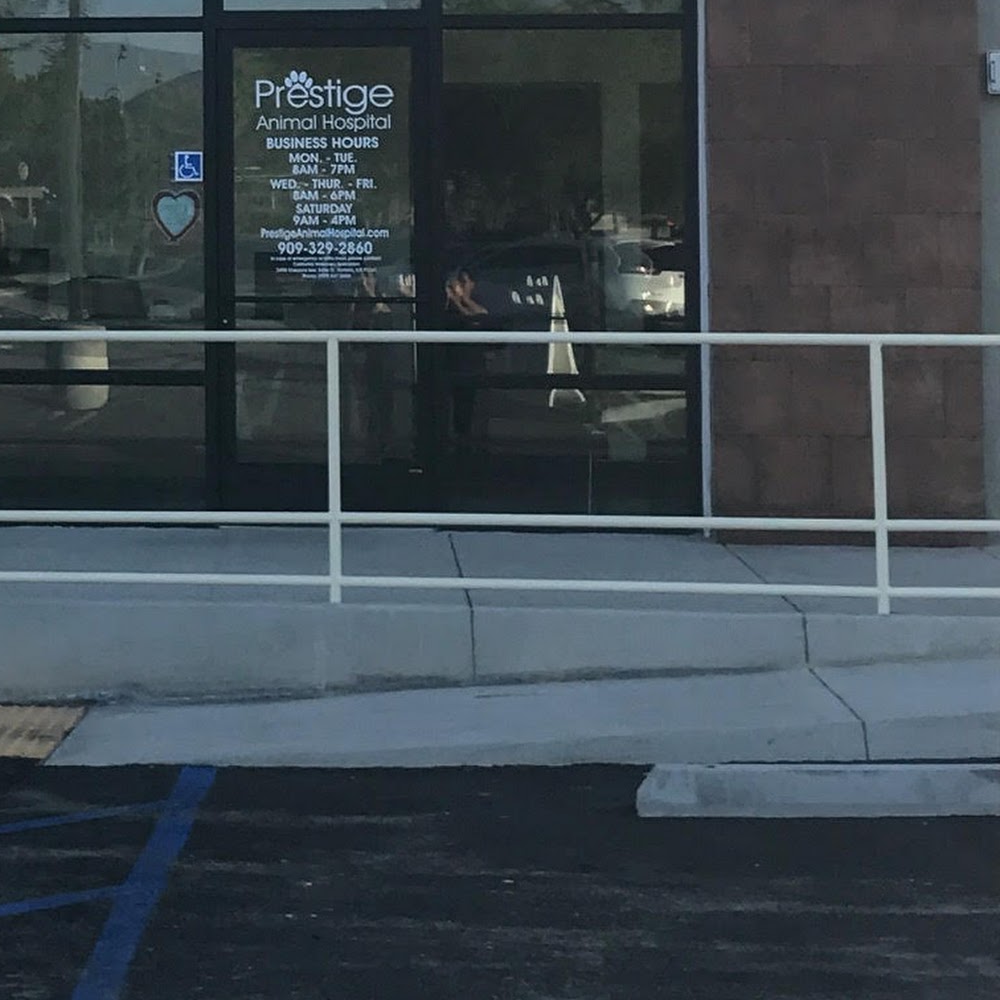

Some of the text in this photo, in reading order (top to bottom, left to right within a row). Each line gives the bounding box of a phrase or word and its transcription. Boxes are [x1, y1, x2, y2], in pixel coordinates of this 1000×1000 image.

[255, 75, 395, 115] Prestige
[255, 113, 392, 132] Animal Hospital
[266, 136, 379, 149] BUSINESS HOURS
[288, 152, 323, 163] MON.
[333, 152, 358, 163] TUE.
[292, 164, 319, 175] 8AM
[330, 164, 356, 175] 7PM
[356, 178, 377, 190] FRI.
[329, 190, 356, 201] 6PM
[295, 203, 353, 214] SATURDAY
[292, 215, 320, 226] 9AM
[330, 215, 357, 226] 4PM
[260, 228, 390, 240] PrestigeAnimalHospital.com
[277, 241, 373, 255] 909-329-2860
